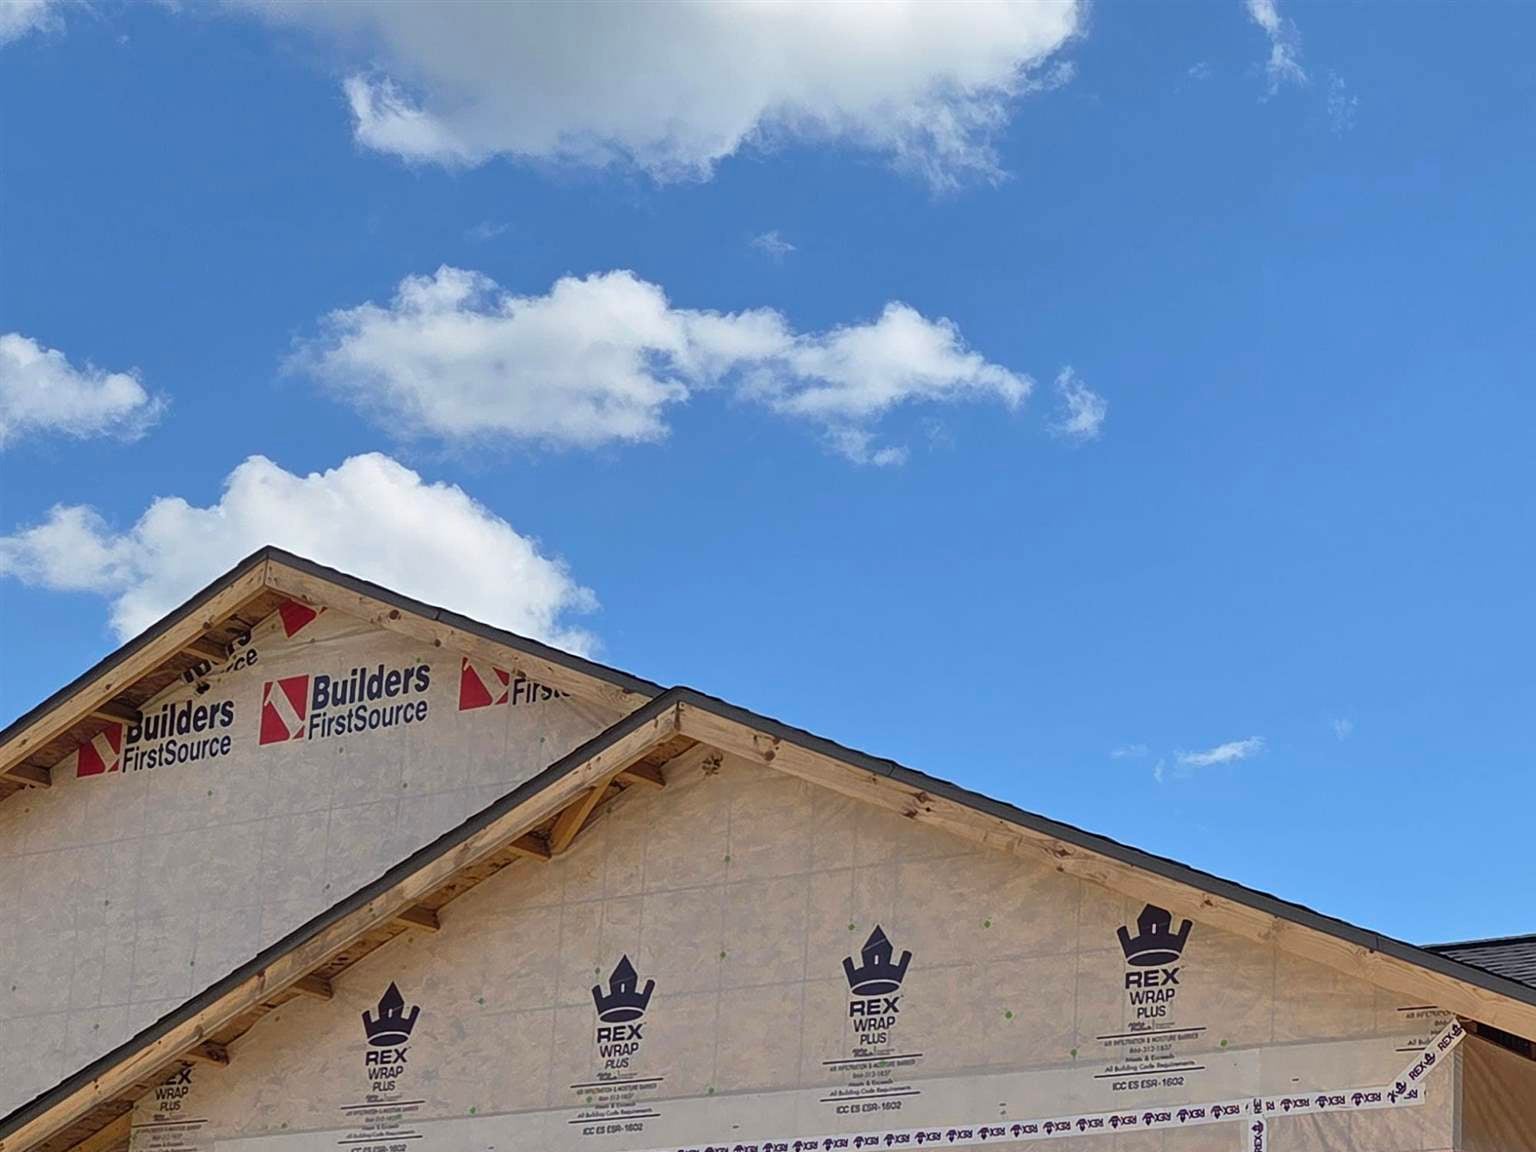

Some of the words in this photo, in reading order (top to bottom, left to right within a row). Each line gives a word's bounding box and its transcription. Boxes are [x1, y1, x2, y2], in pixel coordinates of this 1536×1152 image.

[311, 663, 430, 711] Builders
[126, 699, 235, 745] Builders
[308, 700, 428, 741] FirstSource
[122, 735, 232, 773] FirstSource
[1125, 967, 1180, 990] REX
[1129, 988, 1176, 1006] WRAP
[849, 996, 900, 1018] REX
[1137, 1005, 1167, 1019] PLUS
[597, 1023, 643, 1044] REX
[853, 1016, 896, 1033] WRAP
[860, 1032, 887, 1045] PLUS
[365, 1046, 408, 1067] REX
[600, 1042, 640, 1058] WRAP
[368, 1065, 404, 1081] WRAP
[604, 1059, 629, 1070] PLUS
[154, 1086, 189, 1101] WRAP
[372, 1080, 396, 1092] PLUS
